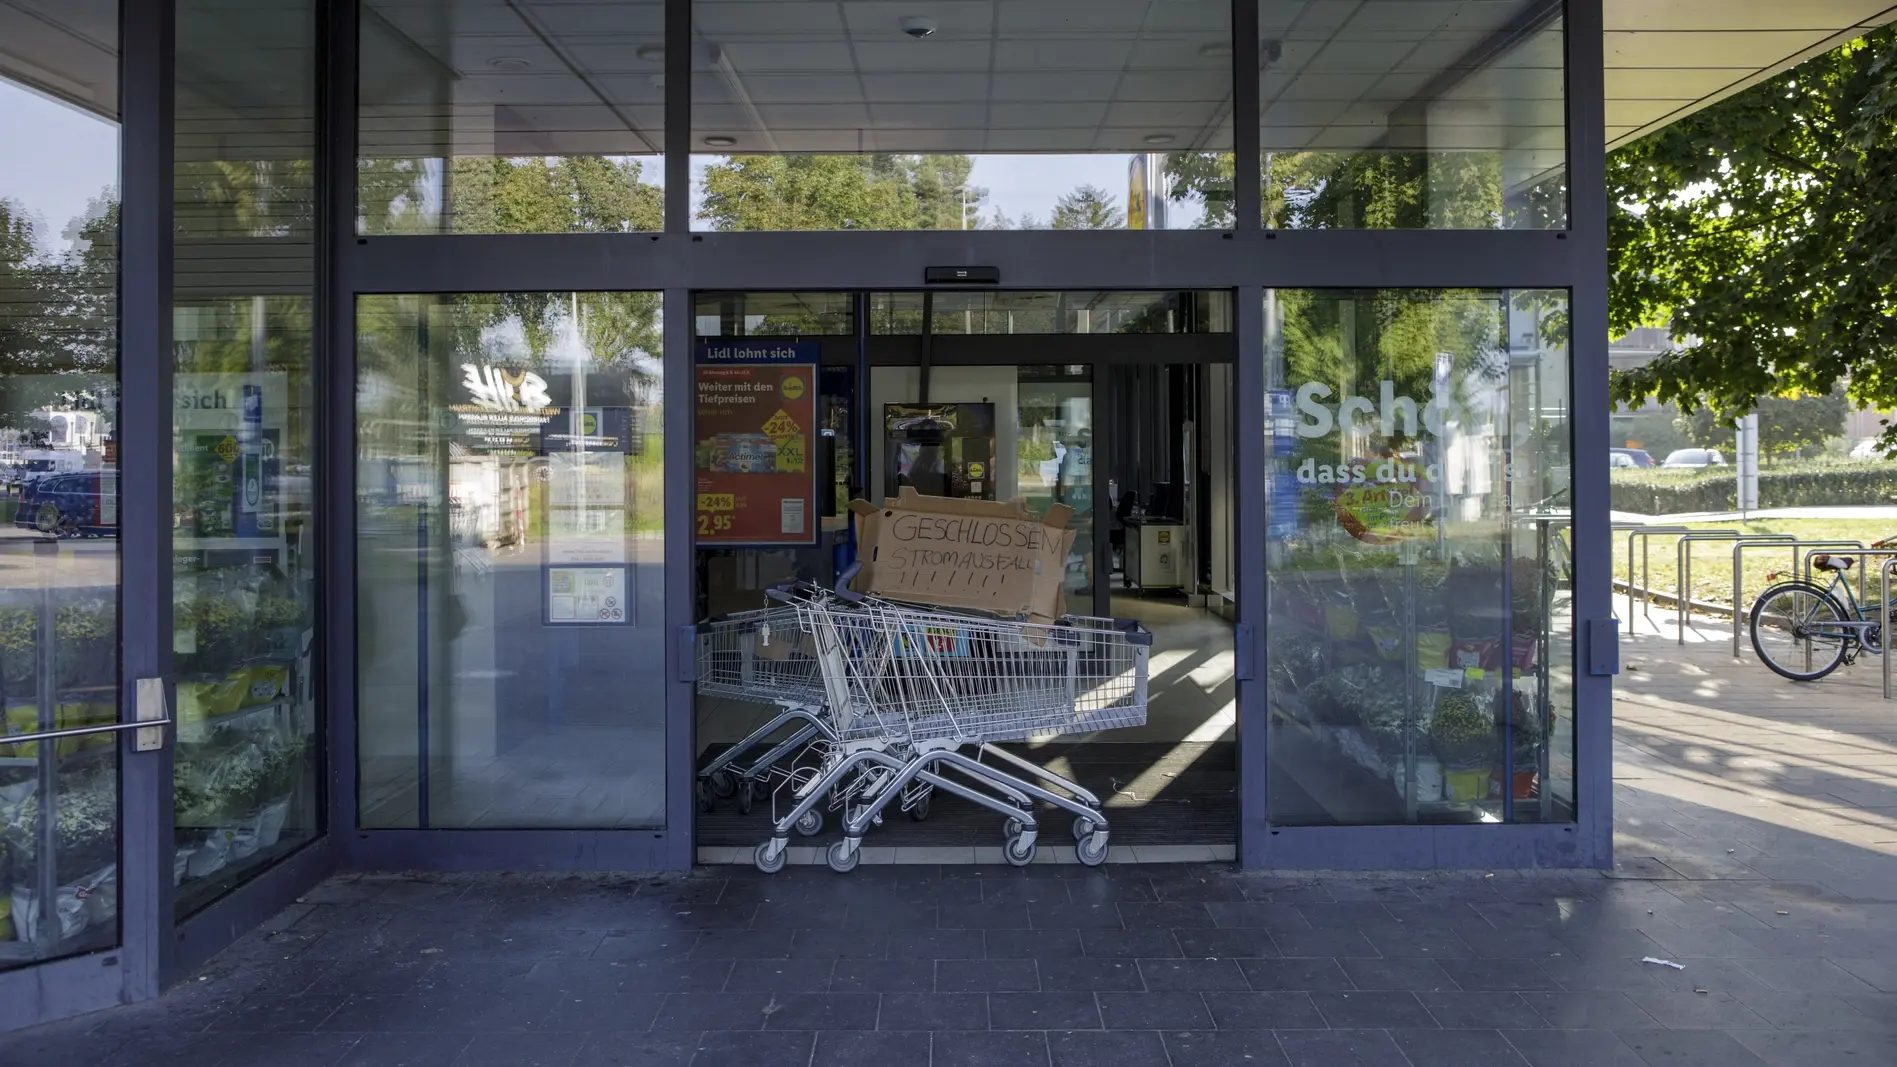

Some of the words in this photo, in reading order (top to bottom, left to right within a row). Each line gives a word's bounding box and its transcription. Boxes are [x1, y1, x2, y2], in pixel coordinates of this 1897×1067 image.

[707, 348, 731, 359] Lidl
[734, 348, 767, 359] lohnt
[770, 348, 796, 359] sich
[698, 382, 733, 392] Weiter
[734, 382, 752, 392] mit
[753, 382, 773, 392] den
[181, 389, 227, 409] sich
[698, 394, 756, 405] Tiefpreisen
[1296, 458, 1366, 484] dass
[1376, 457, 1417, 484] du
[701, 496, 732, 508] -24%
[1389, 491, 1432, 508] Dein
[1389, 518, 1428, 531] freut
[892, 514, 1062, 554] GESCHLOSSEN
[888, 548, 1034, 571] STROMAUSFALL
